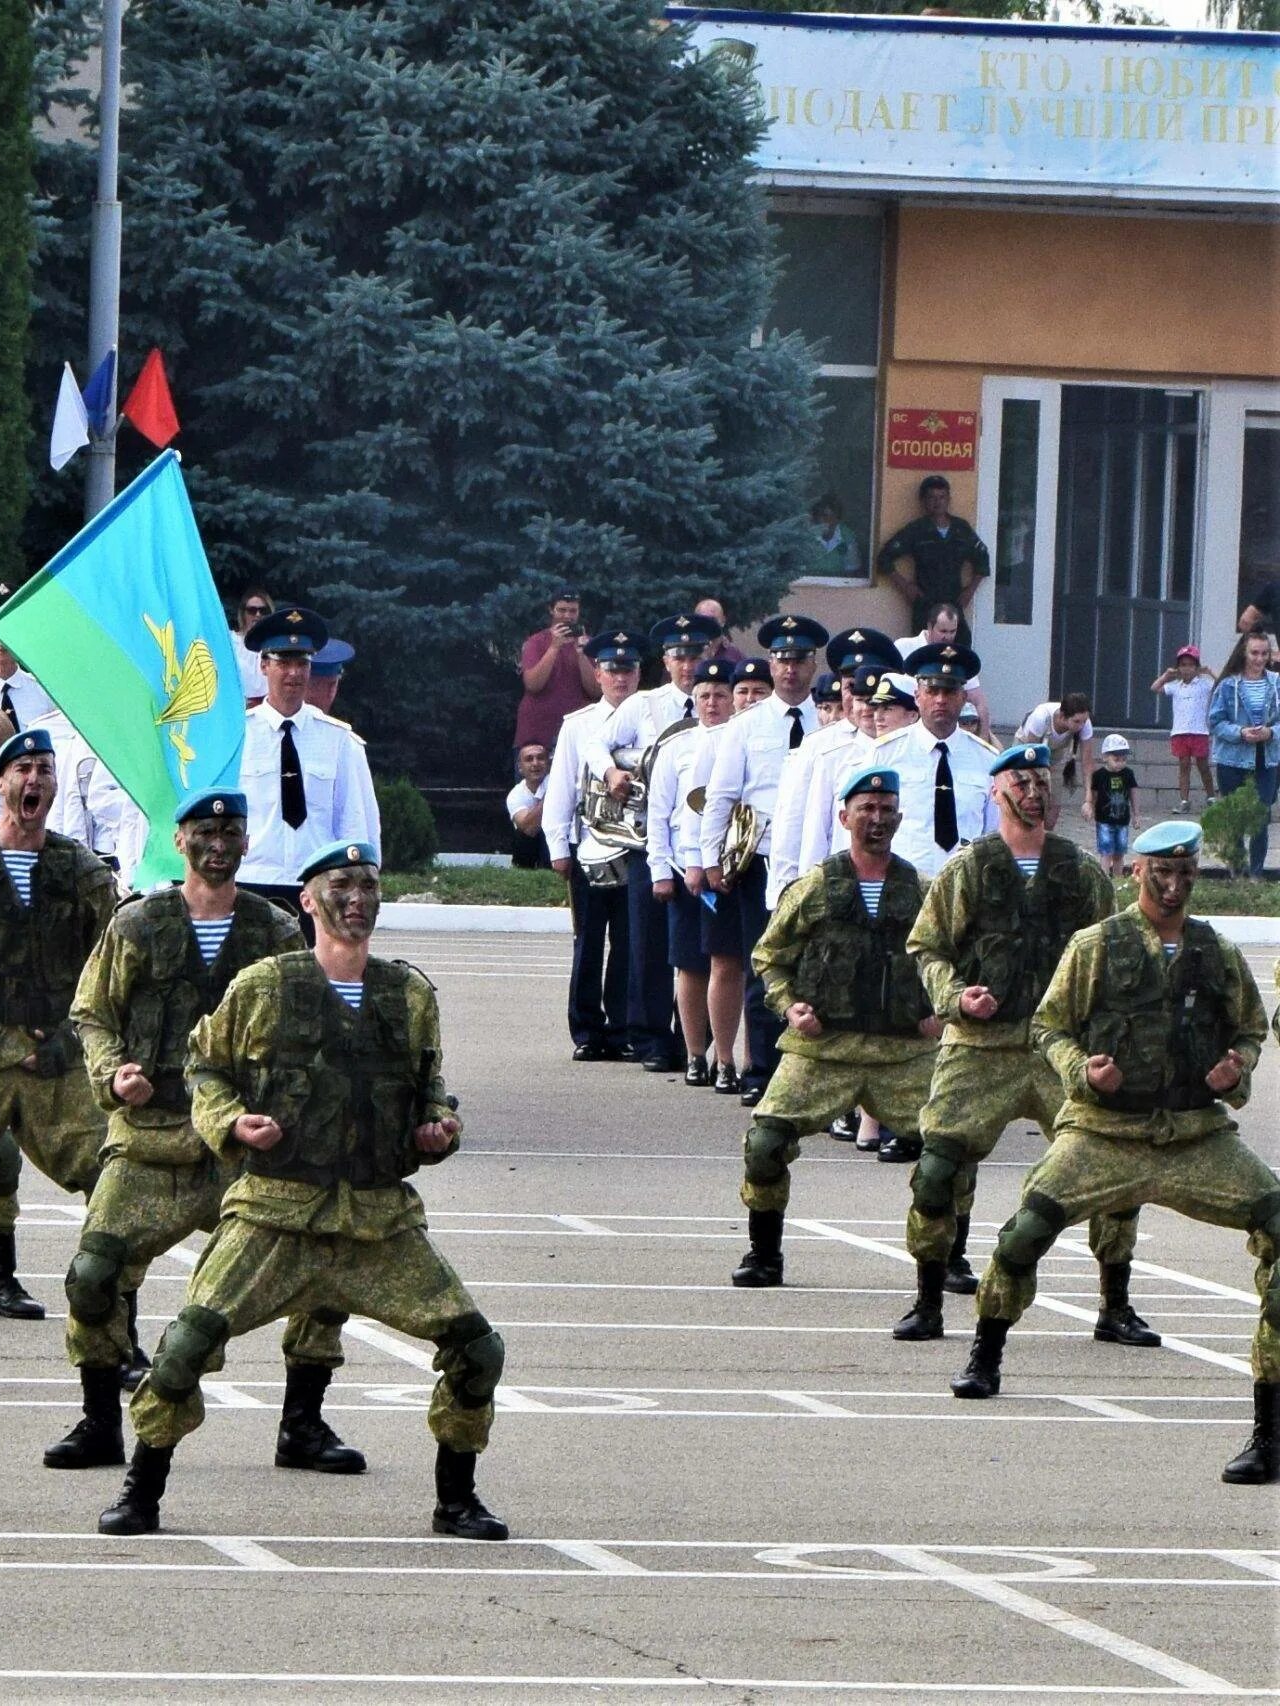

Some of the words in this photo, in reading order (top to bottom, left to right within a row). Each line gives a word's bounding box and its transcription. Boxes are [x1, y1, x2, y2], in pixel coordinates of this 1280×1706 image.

[979, 50, 1072, 92] КТО
[1083, 55, 1260, 98] ЛЮБИТ
[769, 85, 959, 137] ПОДАЕТ
[892, 413, 908, 424] ВС
[957, 415, 974, 426] РФ
[891, 440, 973, 458] СТОЛОВАЯ
